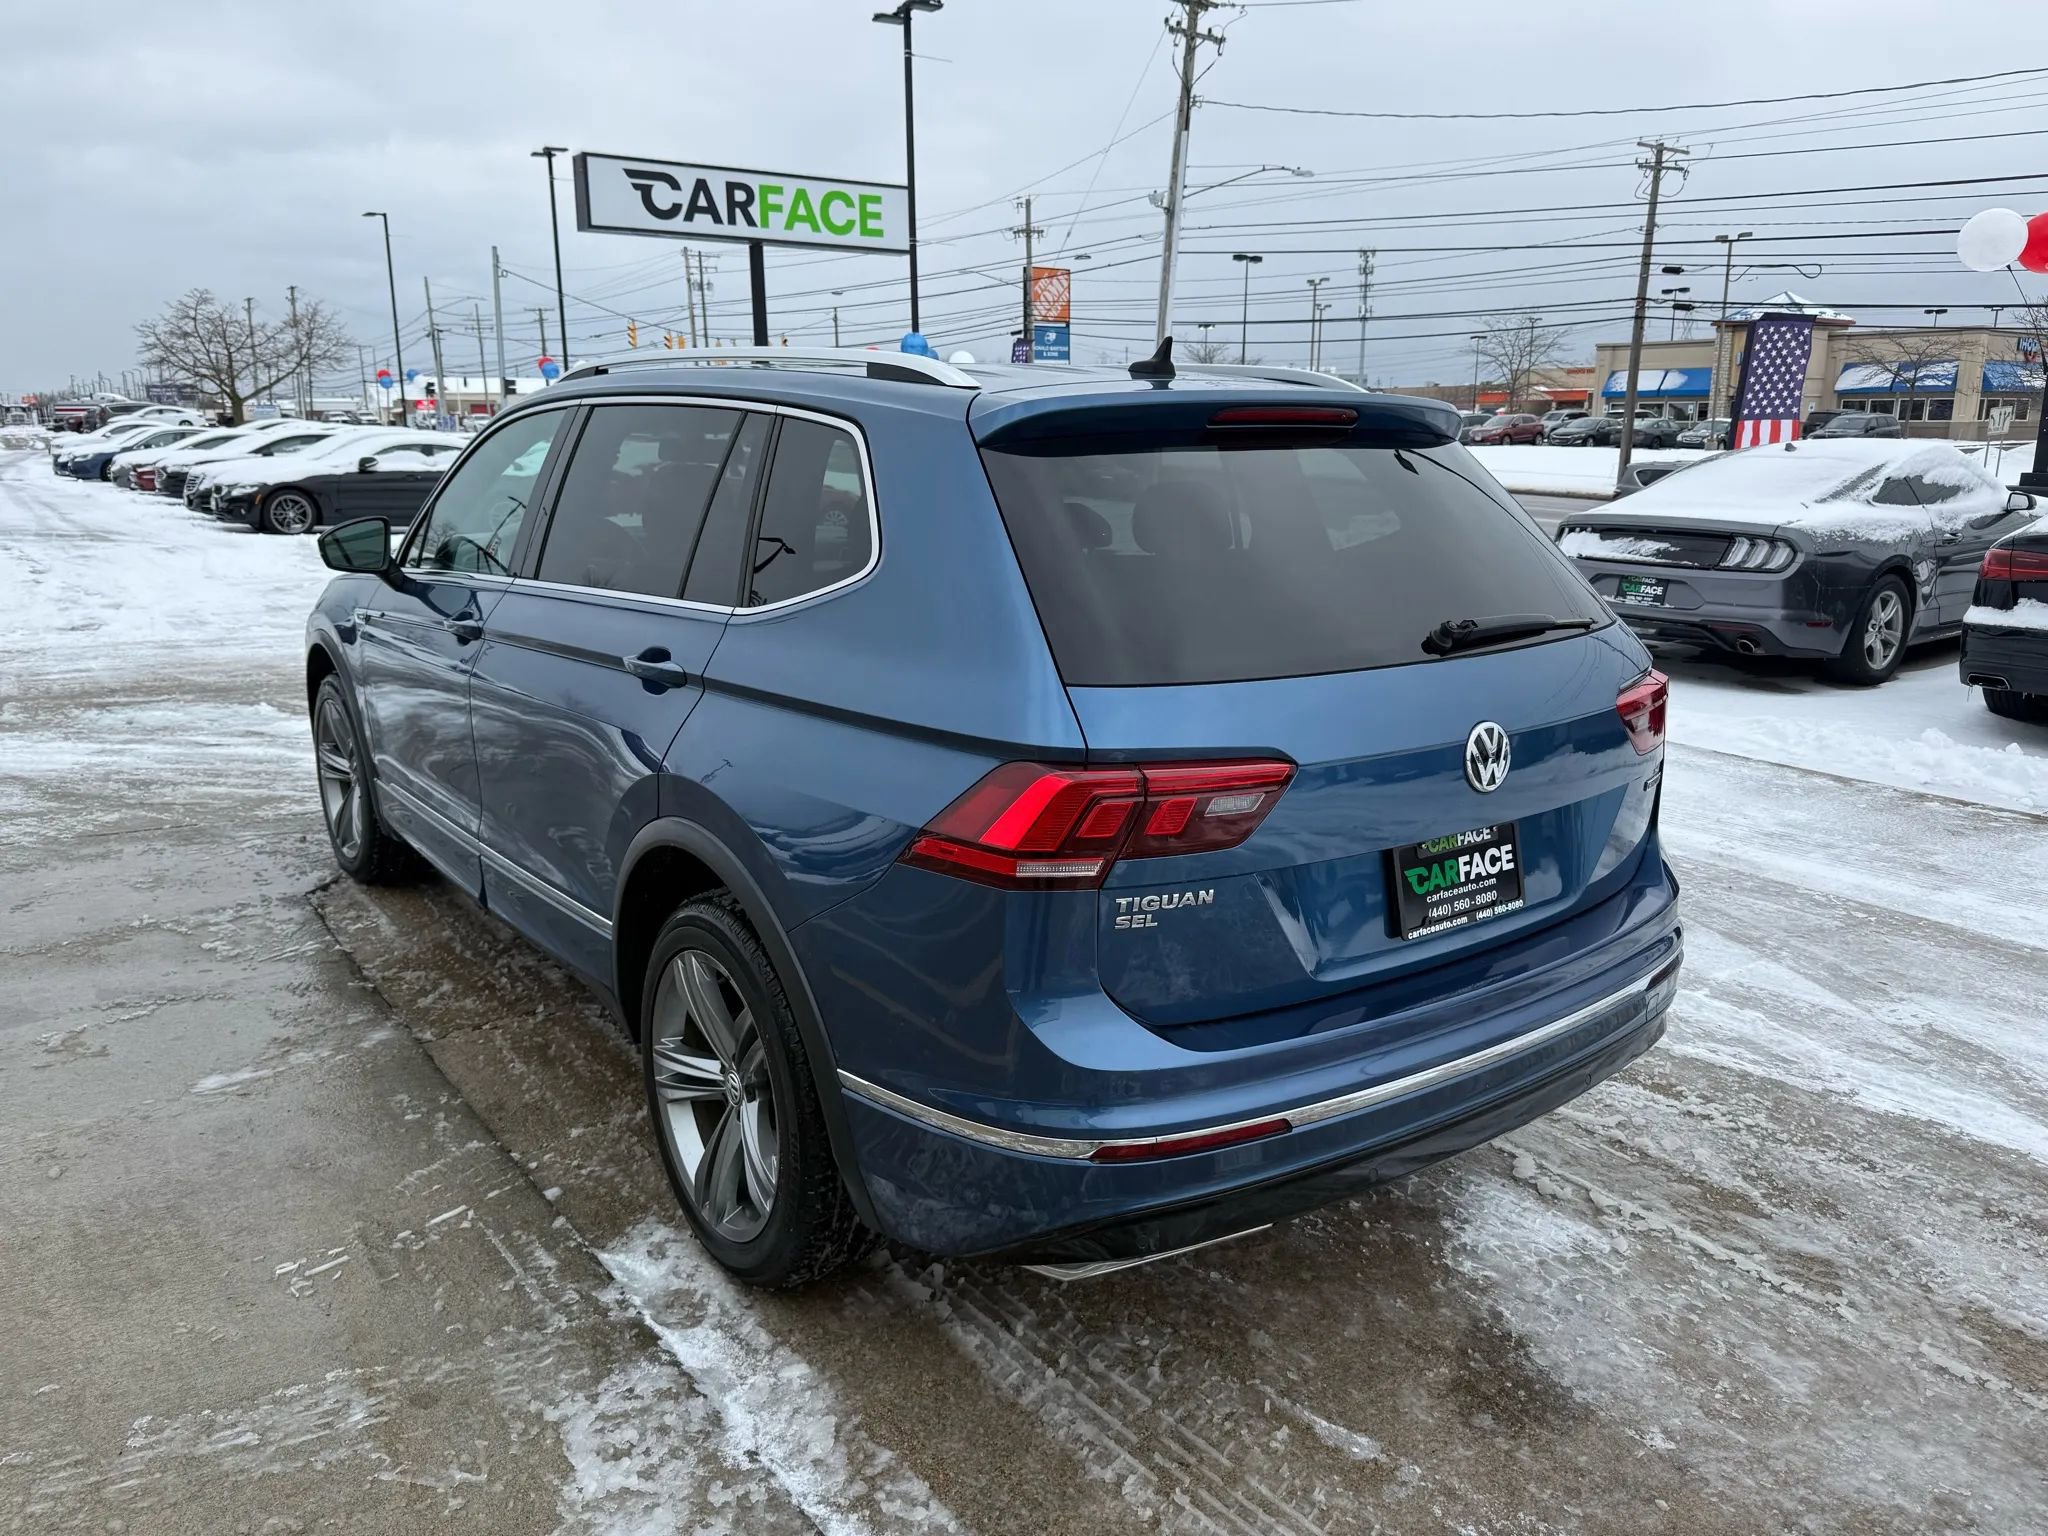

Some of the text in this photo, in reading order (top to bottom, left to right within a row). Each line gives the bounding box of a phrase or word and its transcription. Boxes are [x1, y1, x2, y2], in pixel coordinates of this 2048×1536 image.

[622, 167, 885, 238] CARFACE
[1621, 582, 1664, 595] CARFACE
[1426, 827, 1491, 851] CARFACE
[1404, 844, 1515, 895] CARFACE
[1115, 889, 1214, 913] TIGUAN
[1426, 878, 1497, 903] carfaceauto.com
[1428, 890, 1498, 918] (440) 560-8080
[1114, 914, 1158, 930] SEL
[1408, 916, 1468, 940] carfaceauto.com
[1476, 909, 1494, 921] (440)
